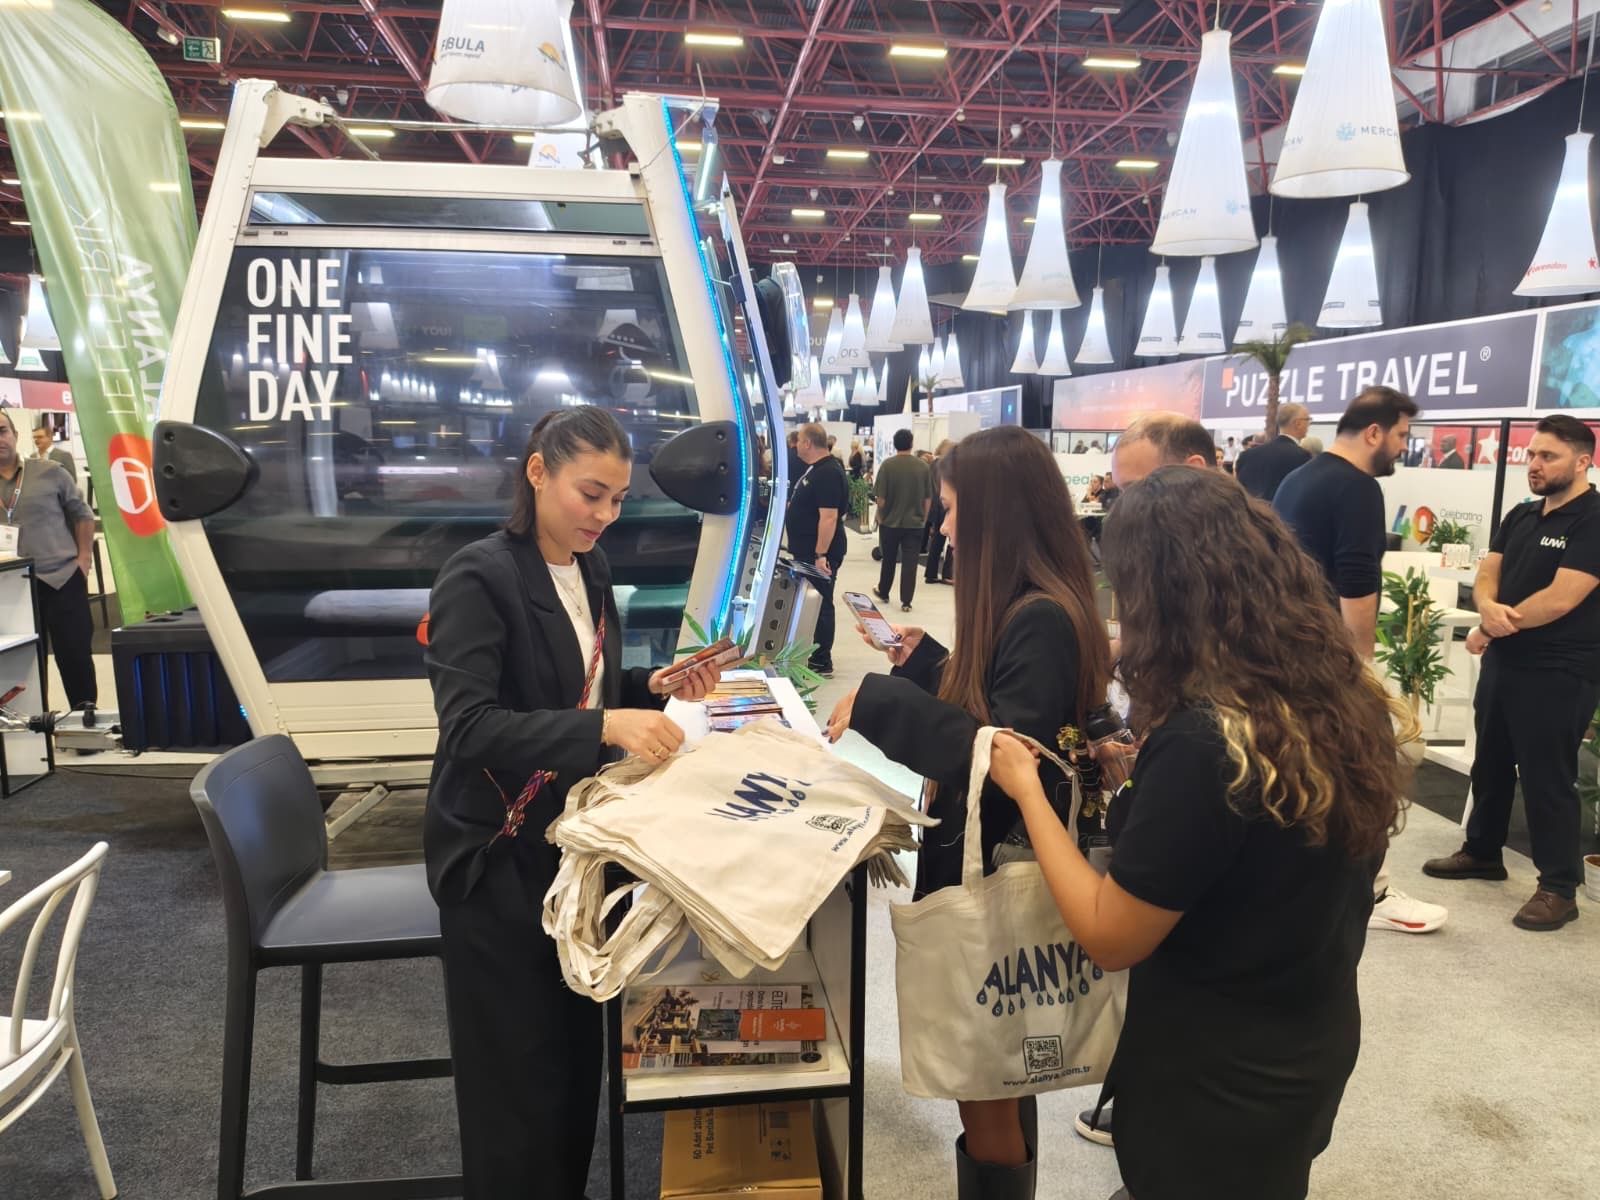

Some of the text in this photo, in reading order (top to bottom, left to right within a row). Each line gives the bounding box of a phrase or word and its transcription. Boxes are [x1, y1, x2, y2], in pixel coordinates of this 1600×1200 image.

[247, 258, 341, 308] ONE
[248, 314, 353, 364] FINE
[249, 370, 339, 421] DAY
[1226, 365, 1326, 408] PUZZLE
[1337, 350, 1478, 400] TRAVEL
